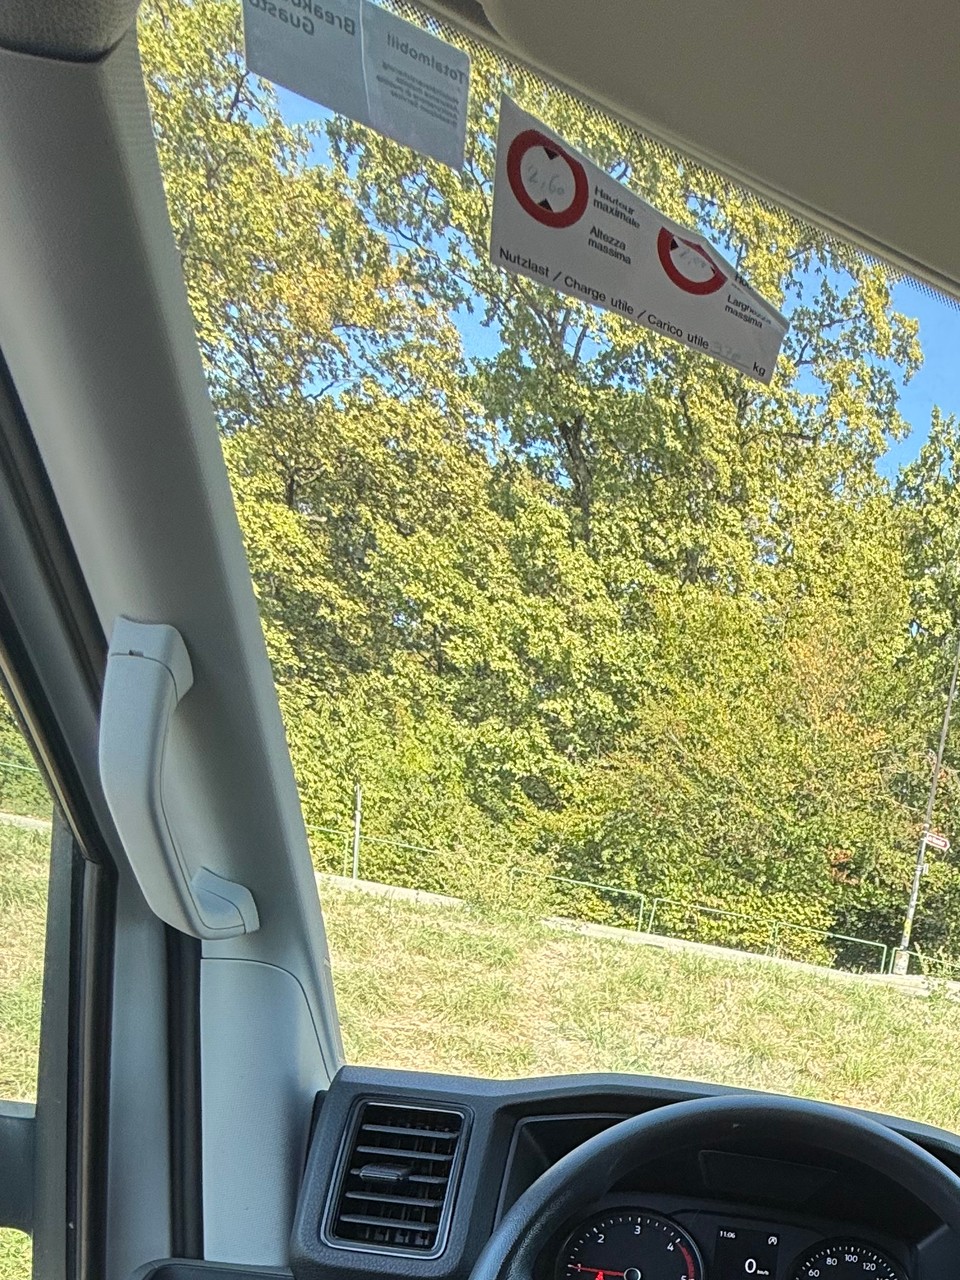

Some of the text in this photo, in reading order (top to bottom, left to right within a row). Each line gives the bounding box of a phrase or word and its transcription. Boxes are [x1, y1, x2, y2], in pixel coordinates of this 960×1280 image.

[594, 185, 635, 215] Hauteur
[593, 198, 640, 229] maximale
[589, 225, 626, 250] Altezza
[588, 238, 632, 265] massima
[499, 247, 550, 279] Nutzlast
[564, 275, 606, 302] Charge
[610, 294, 634, 315] utile
[647, 313, 683, 339] Carico
[687, 331, 709, 350] utile
[752, 361, 766, 377] kg
[724, 305, 763, 329] massima
[634, 1225, 641, 1234] 3
[597, 1234, 605, 1243] 2
[666, 1243, 674, 1251] 4
[826, 1257, 838, 1265] 80
[844, 1254, 858, 1262] 100
[862, 1262, 876, 1271] 120
[808, 1269, 820, 1277] 60
